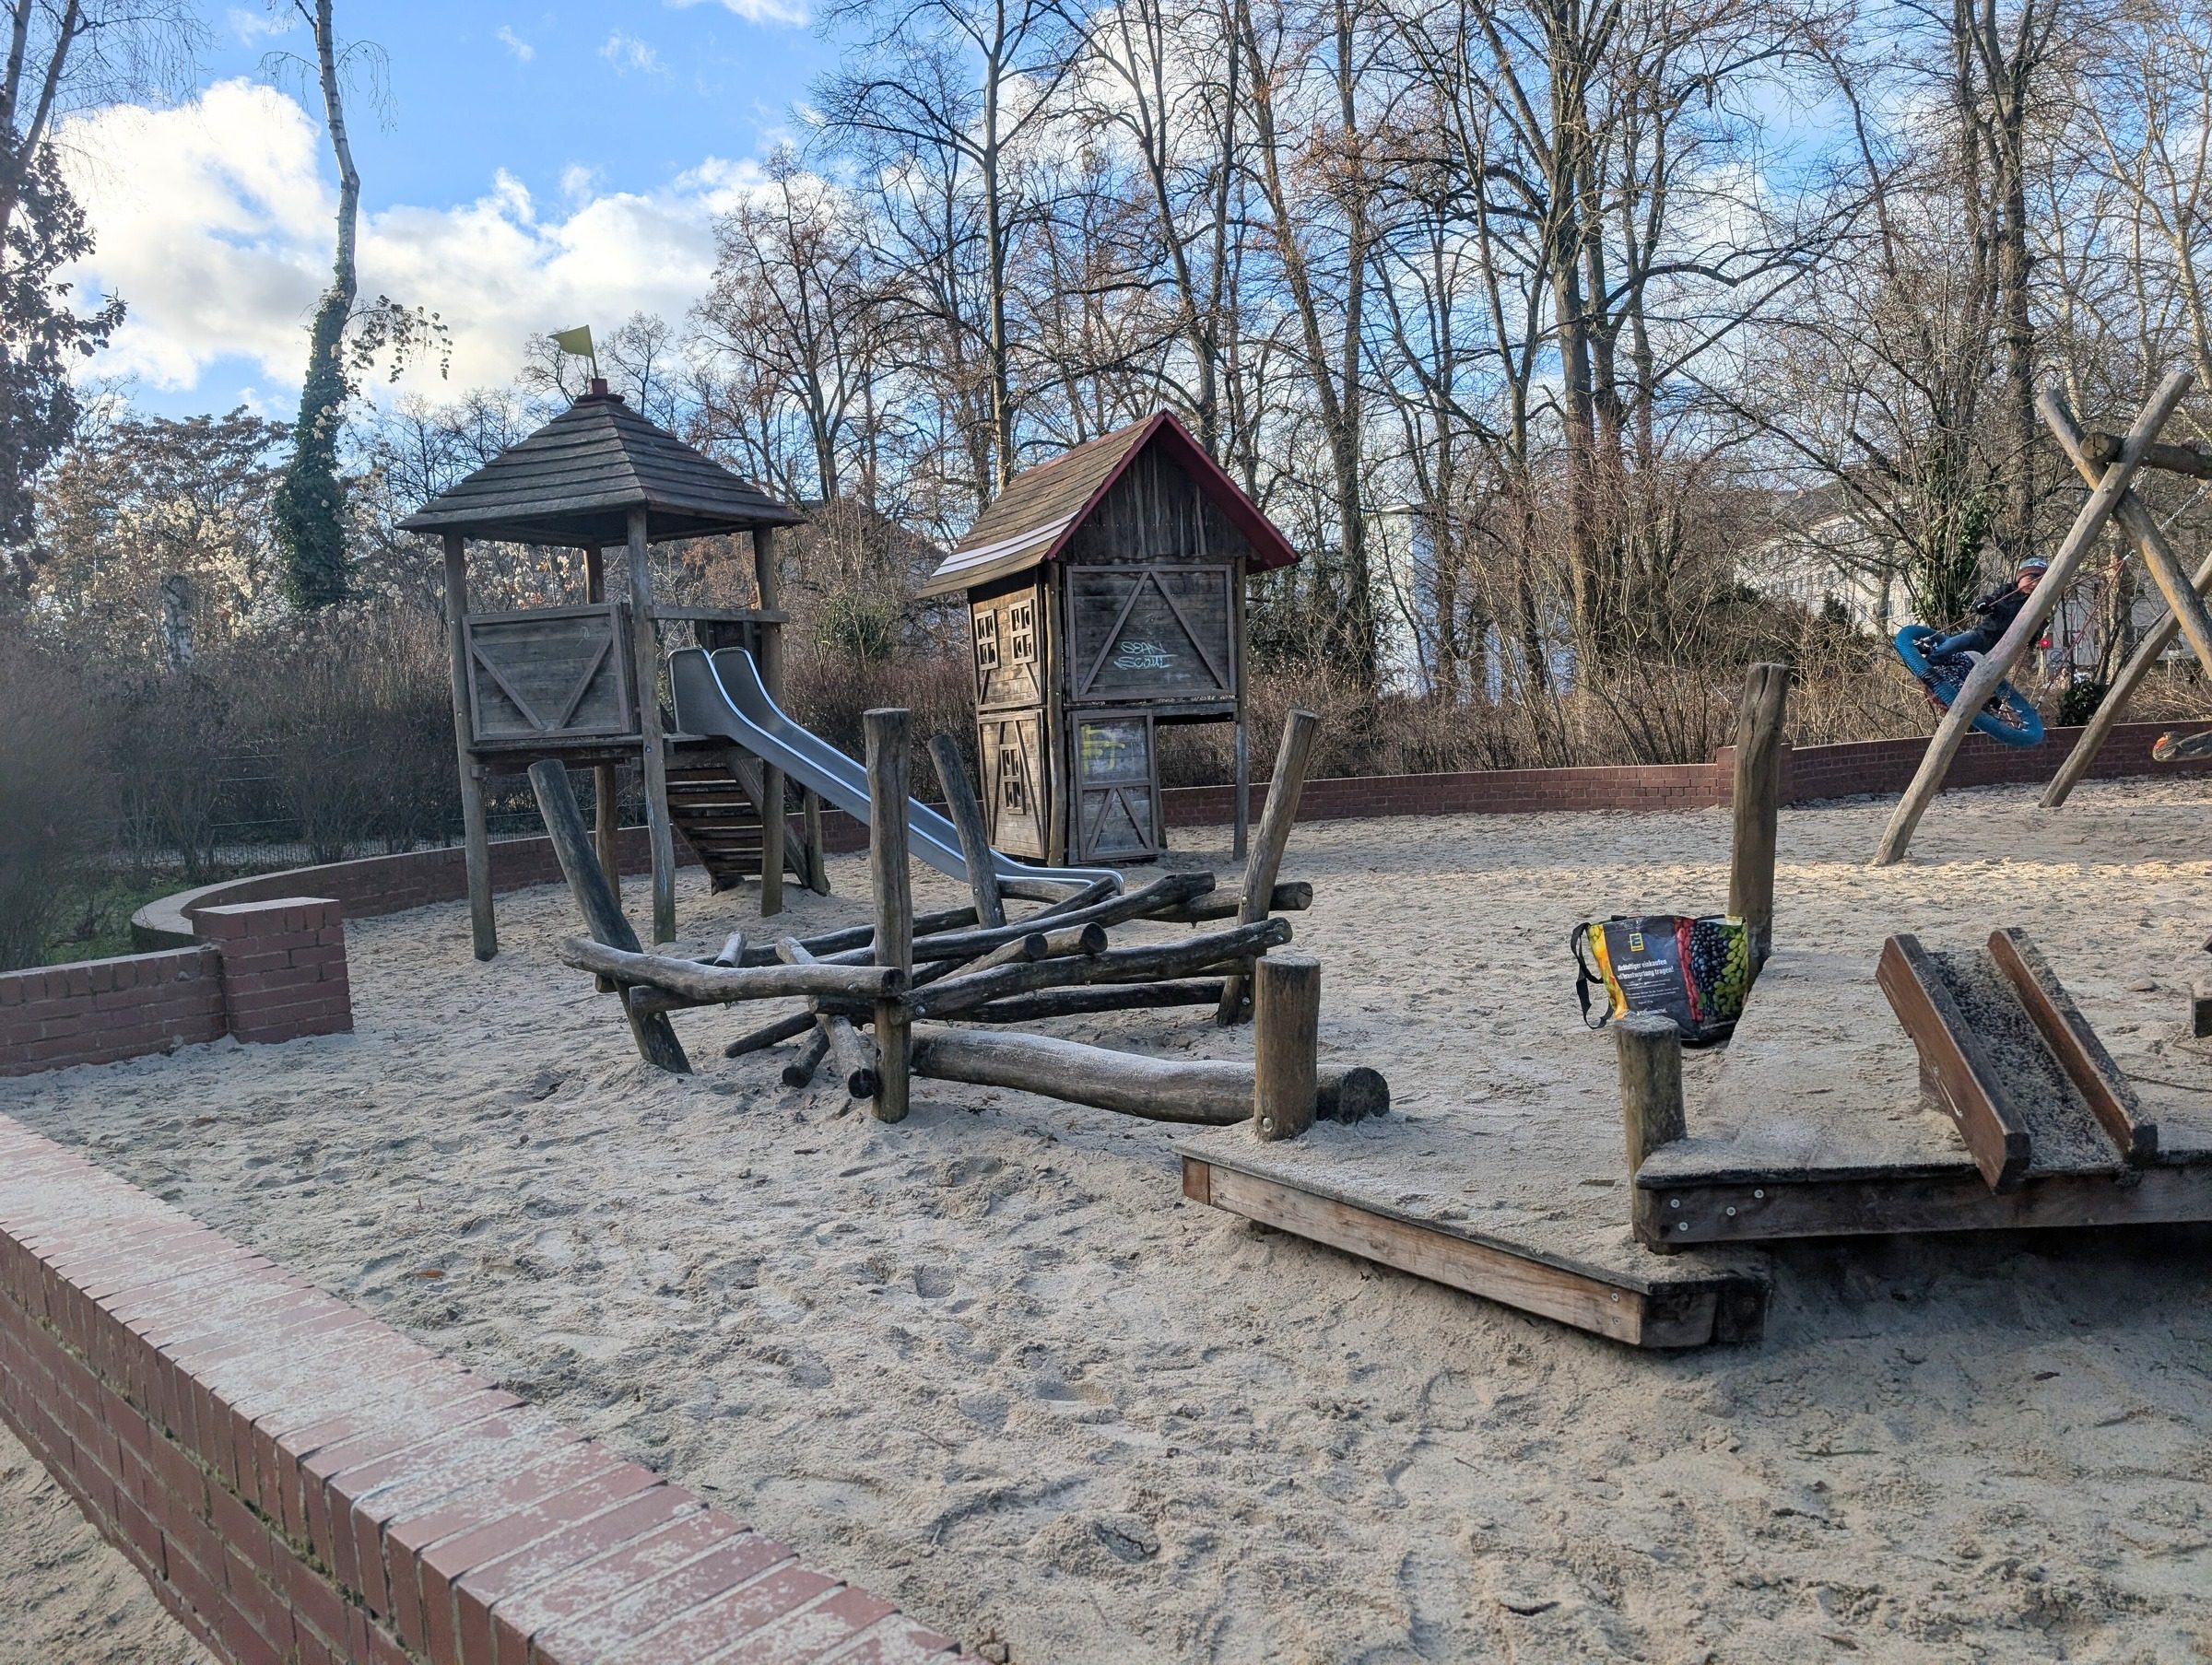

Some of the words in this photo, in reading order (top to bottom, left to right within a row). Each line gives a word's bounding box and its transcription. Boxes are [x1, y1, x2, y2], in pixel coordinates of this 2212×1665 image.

[1641, 958, 1667, 967] einkaufen
[1617, 970, 1654, 979] rantwortung
[1654, 965, 1674, 975] tragen!
